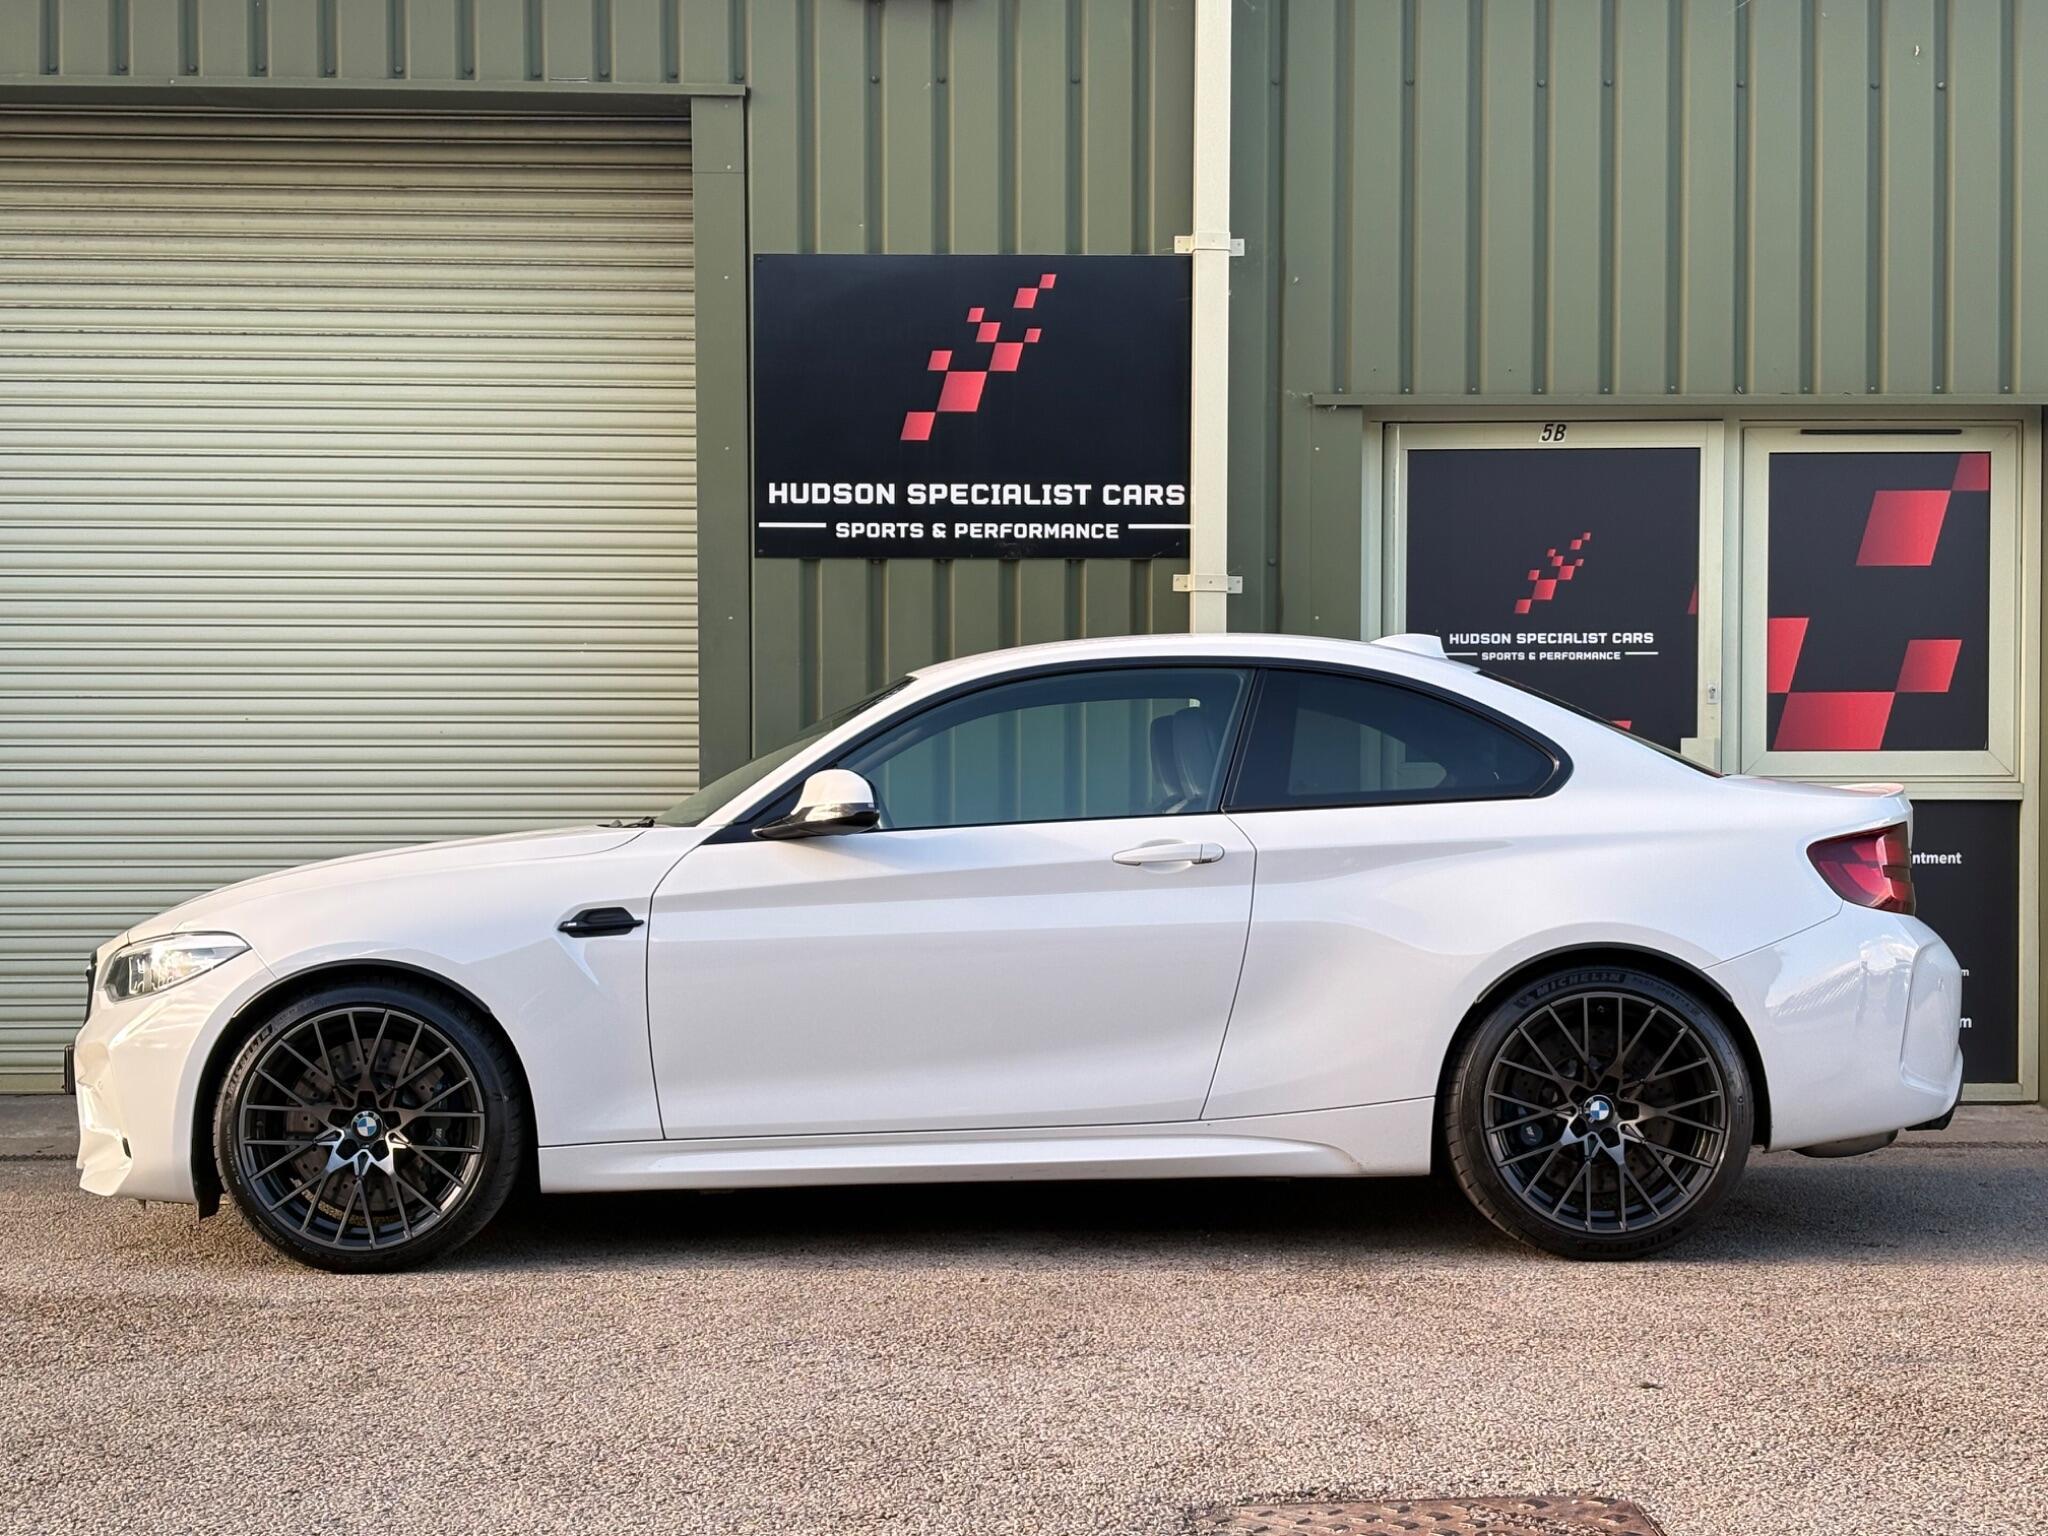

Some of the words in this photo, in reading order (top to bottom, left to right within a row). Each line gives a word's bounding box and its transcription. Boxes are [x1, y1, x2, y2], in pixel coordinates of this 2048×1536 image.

[1541, 423, 1567, 442] 5B
[769, 483, 896, 505] HUDSON
[907, 483, 1092, 506] SPECIALIST
[1102, 484, 1186, 506] CARS
[835, 522, 924, 539] SPORTS
[932, 522, 947, 539] &
[954, 522, 1120, 540] PERFORMANCE
[1449, 633, 1512, 645] HUDSON
[1516, 632, 1608, 645] SPECIALIST
[1612, 632, 1654, 644] CARS
[1481, 651, 1526, 661] SPORTS
[1528, 651, 1536, 661] &
[1539, 651, 1622, 661] PERFORMANCE
